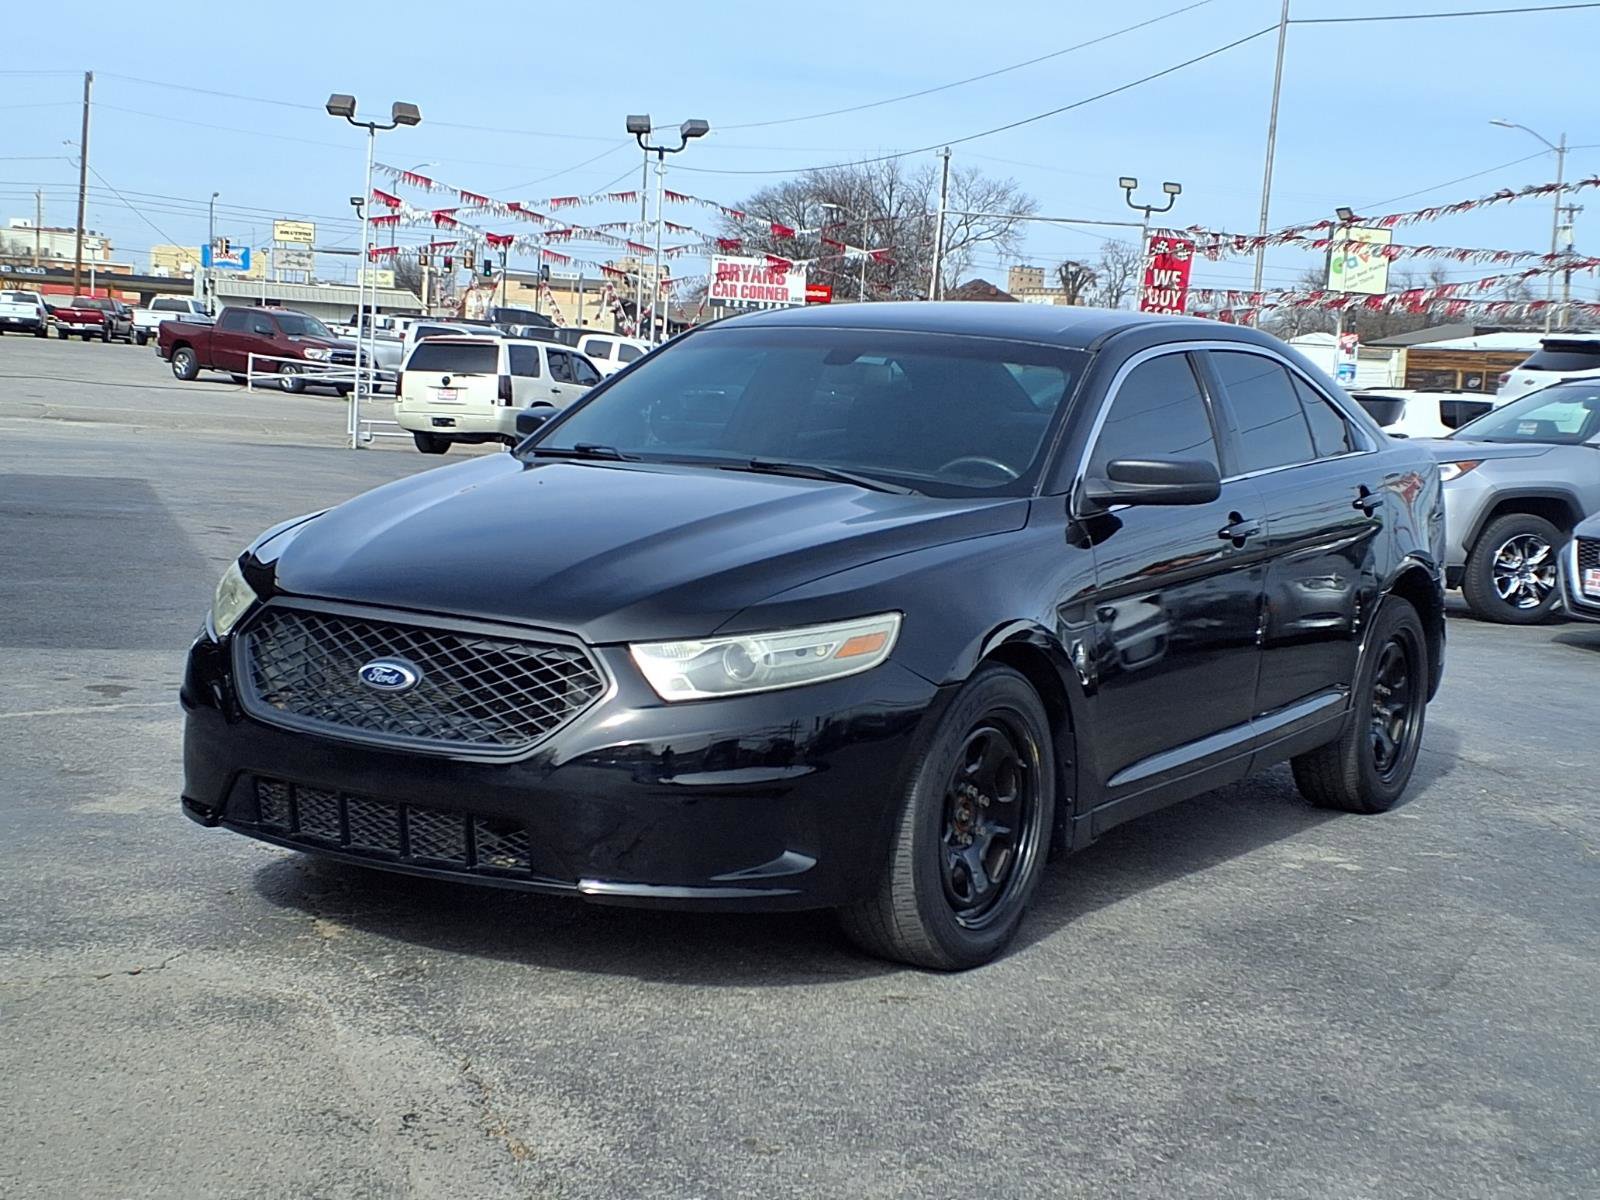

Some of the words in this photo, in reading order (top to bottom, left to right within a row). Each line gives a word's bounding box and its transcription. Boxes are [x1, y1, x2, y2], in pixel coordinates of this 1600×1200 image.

[717, 262, 786, 286] BRYANS
[1153, 268, 1183, 288] WE
[712, 283, 738, 298] CAR
[740, 284, 789, 302] CORNER
[1147, 288, 1182, 308] BUY
[367, 667, 400, 684] Ford
